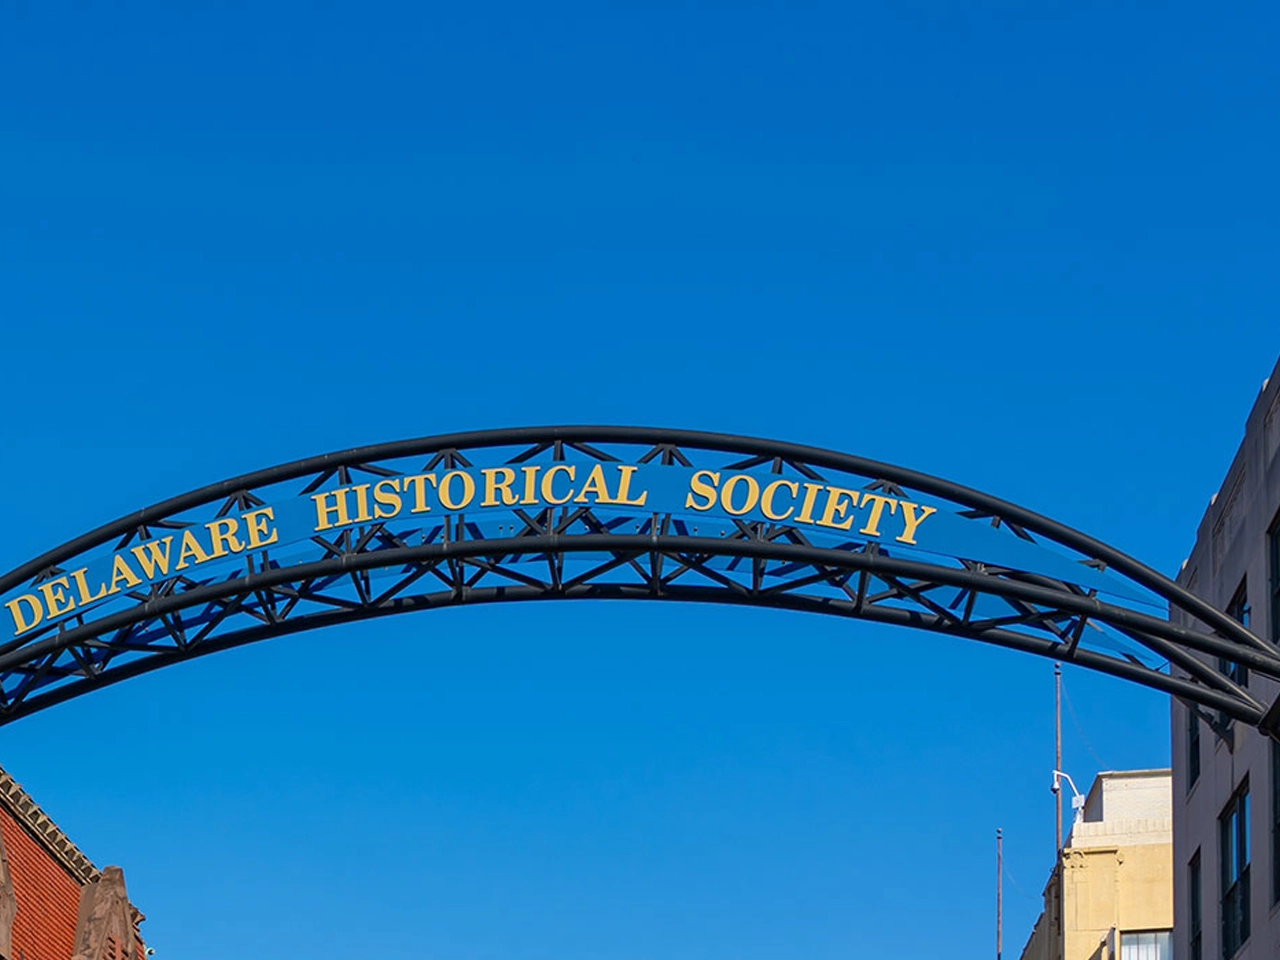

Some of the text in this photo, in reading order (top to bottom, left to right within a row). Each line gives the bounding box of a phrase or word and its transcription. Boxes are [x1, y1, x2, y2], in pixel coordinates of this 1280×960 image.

[4, 464, 937, 636] DELAWARE HISTORICAL SOCIETY
